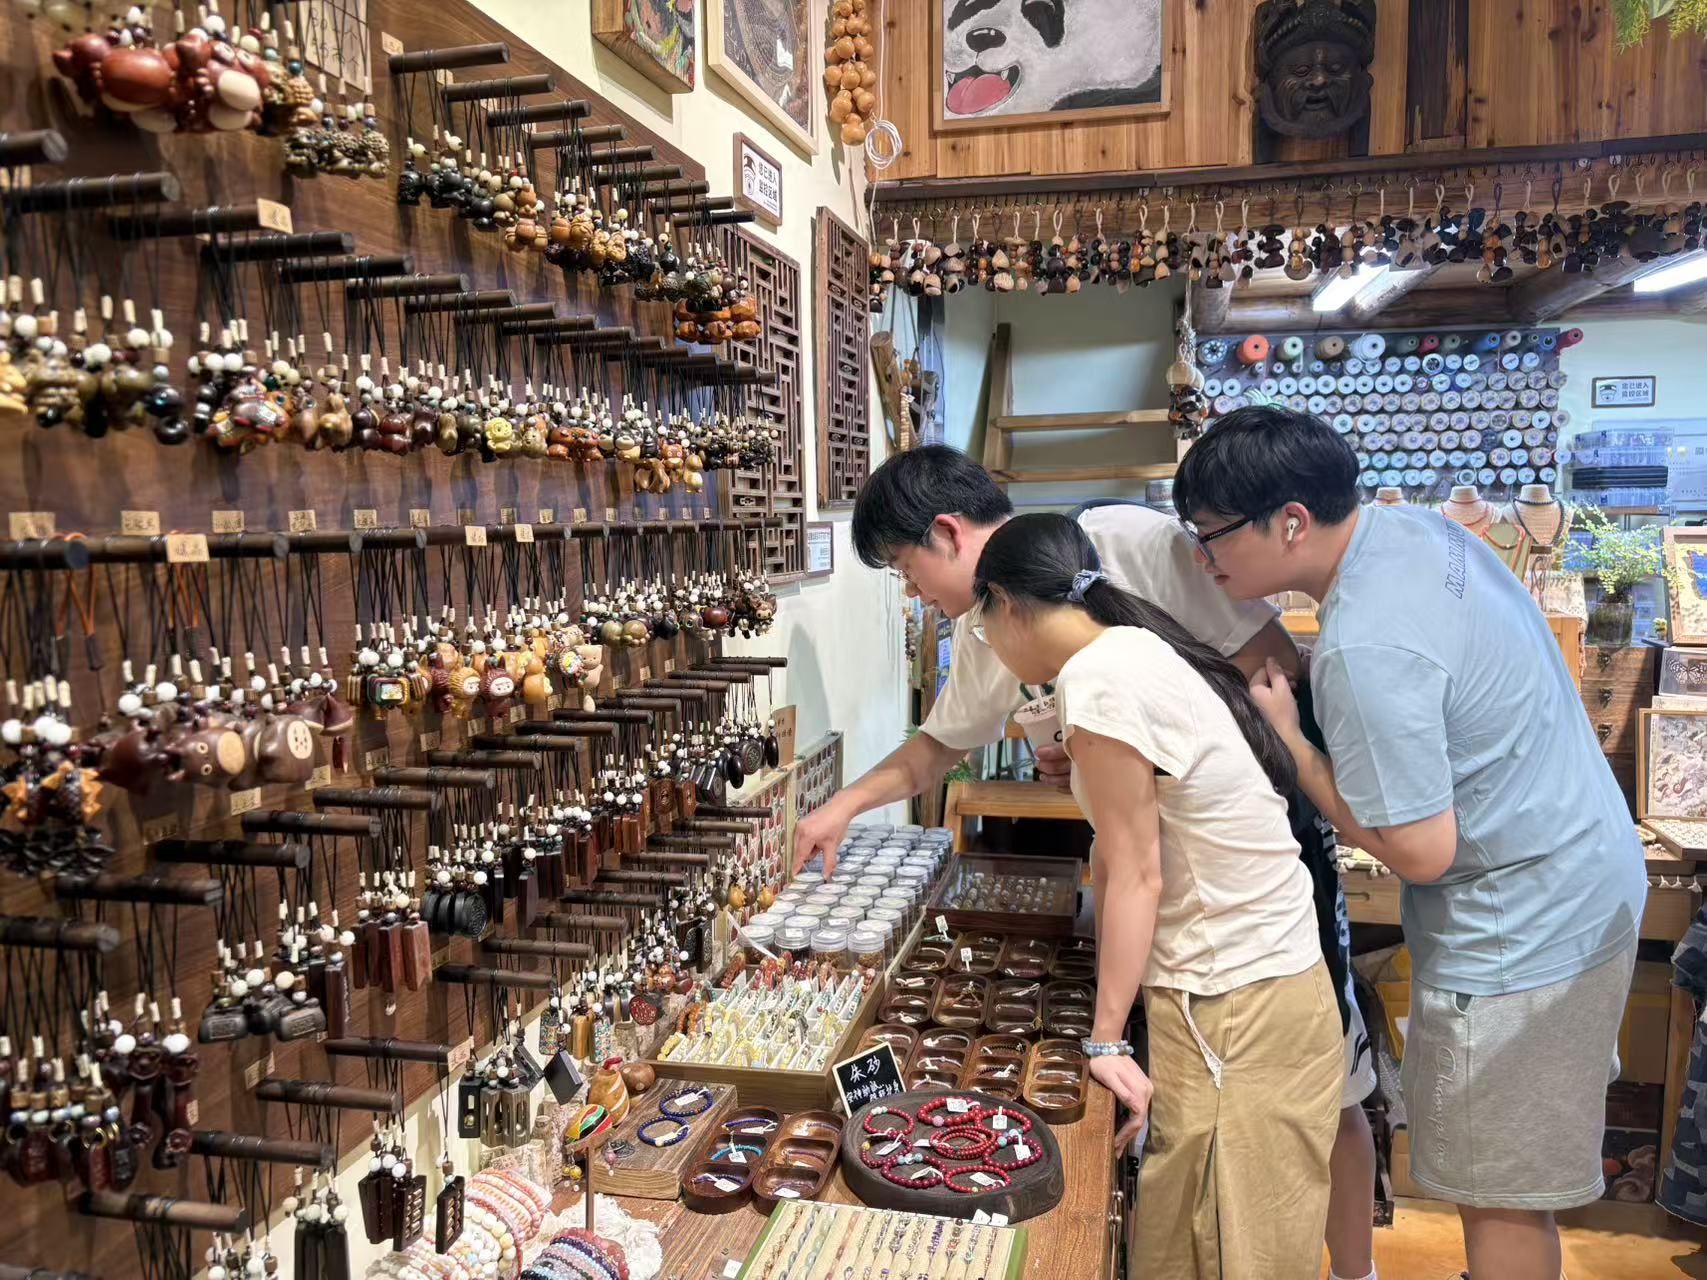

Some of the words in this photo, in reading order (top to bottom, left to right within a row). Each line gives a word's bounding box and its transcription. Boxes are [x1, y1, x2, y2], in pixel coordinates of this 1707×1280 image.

[758, 161, 777, 186] 您已进入
[758, 179, 777, 202] 监控区域
[849, 1055, 881, 1083] 朱砂
